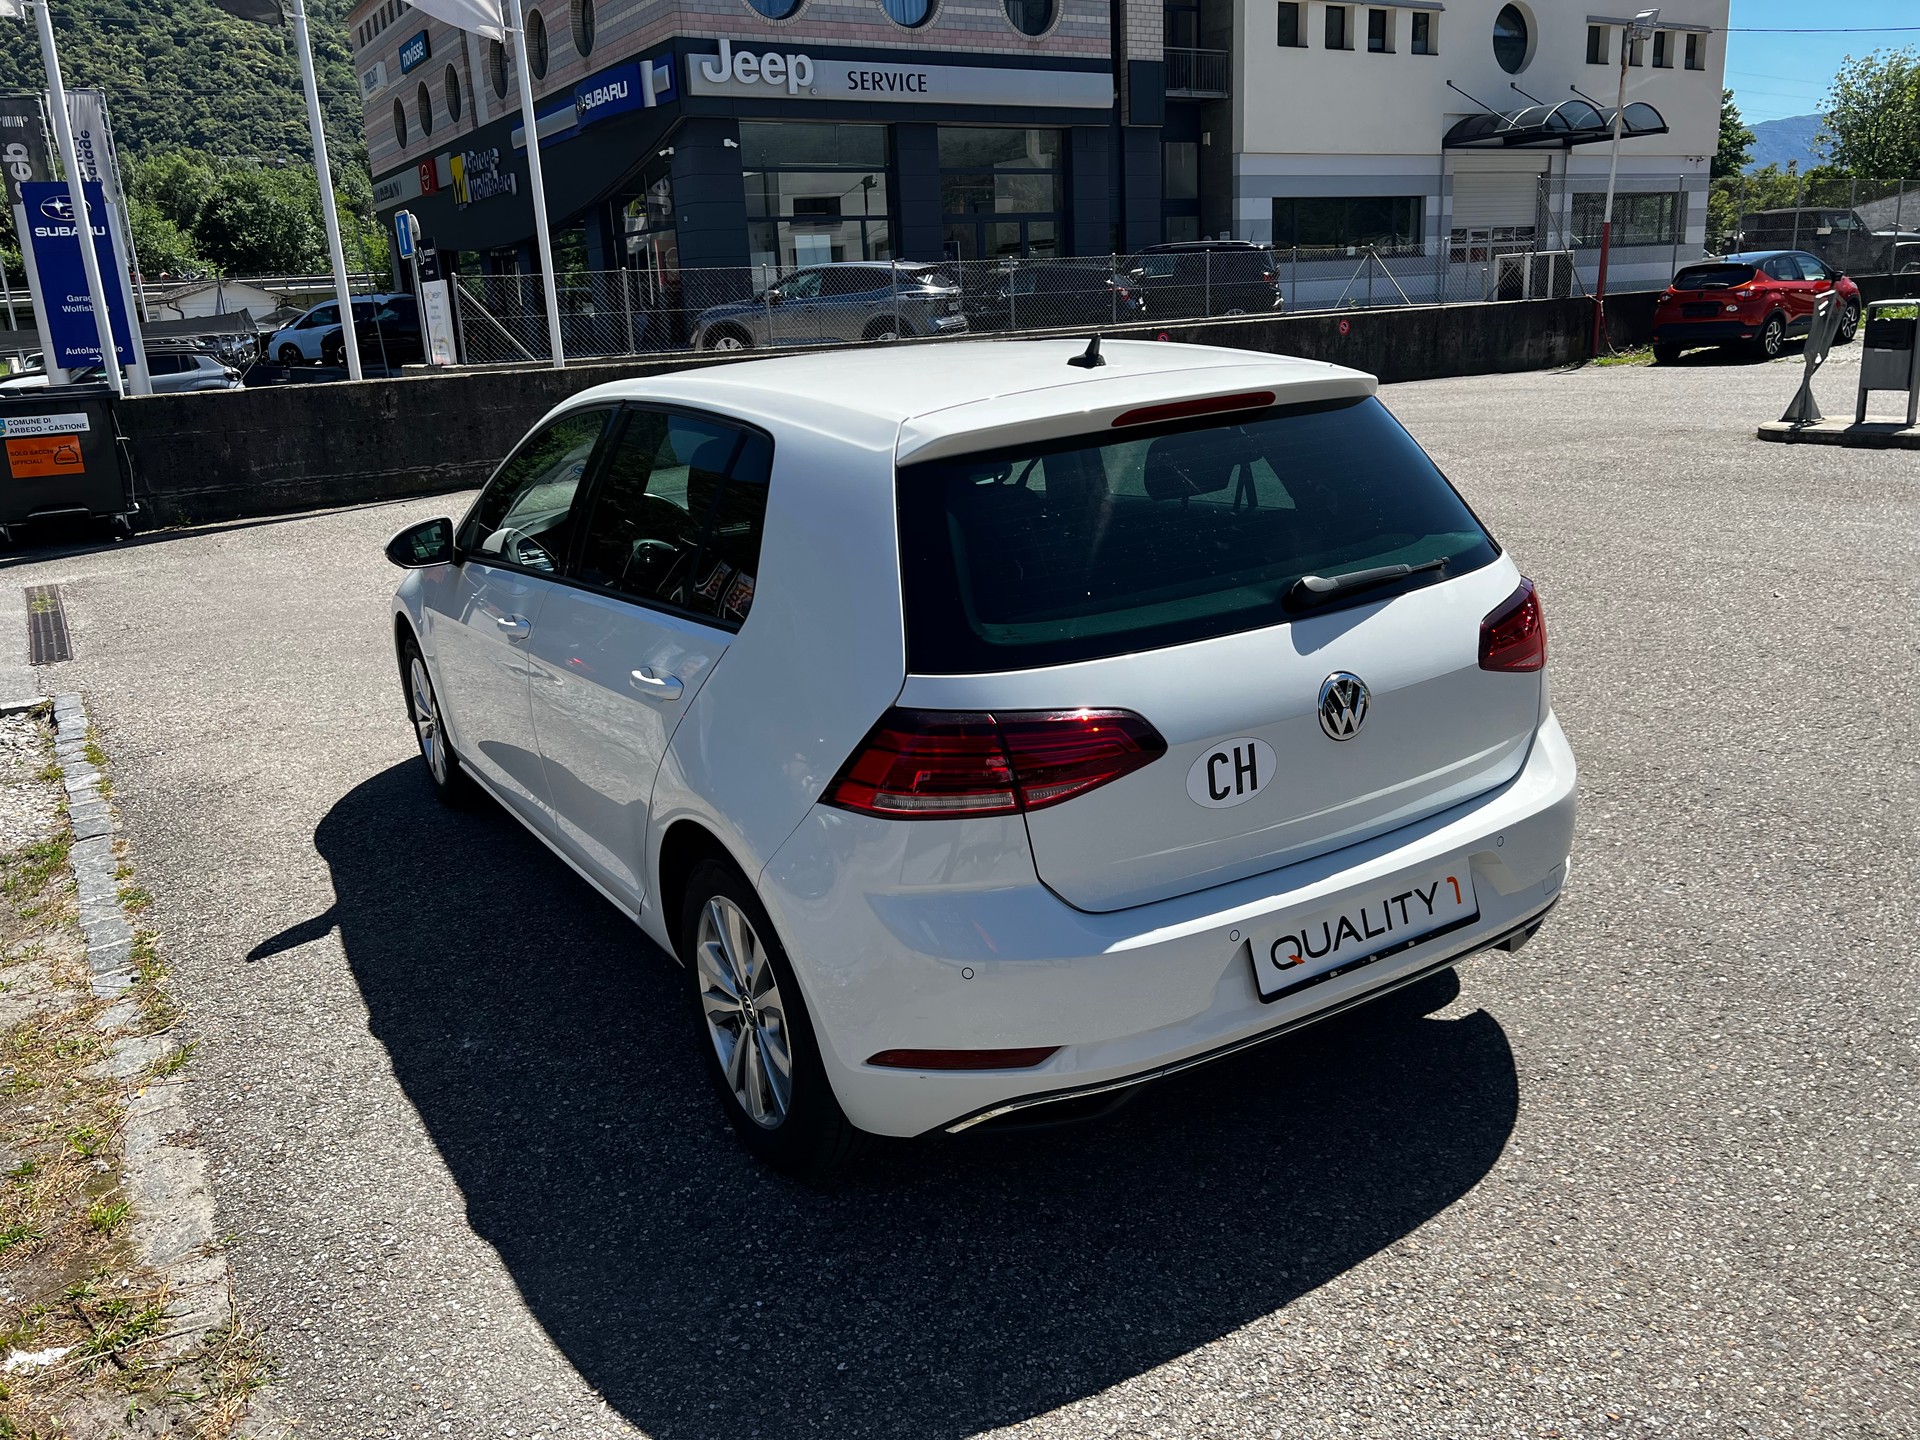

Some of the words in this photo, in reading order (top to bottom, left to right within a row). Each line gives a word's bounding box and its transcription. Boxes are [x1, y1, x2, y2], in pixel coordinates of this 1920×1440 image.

[402, 40, 424, 68] novisse
[701, 38, 815, 95] Jeep
[847, 71, 928, 93] SERVICE
[584, 80, 628, 110] SUBARU
[35, 226, 106, 237] SUBAU
[7, 418, 41, 427] COMUNE
[43, 417, 51, 425] DI
[9, 426, 42, 434] ARBEDO
[48, 423, 87, 432] CASTIONE
[1206, 742, 1258, 801] CH
[1270, 880, 1440, 971] QUALITY
